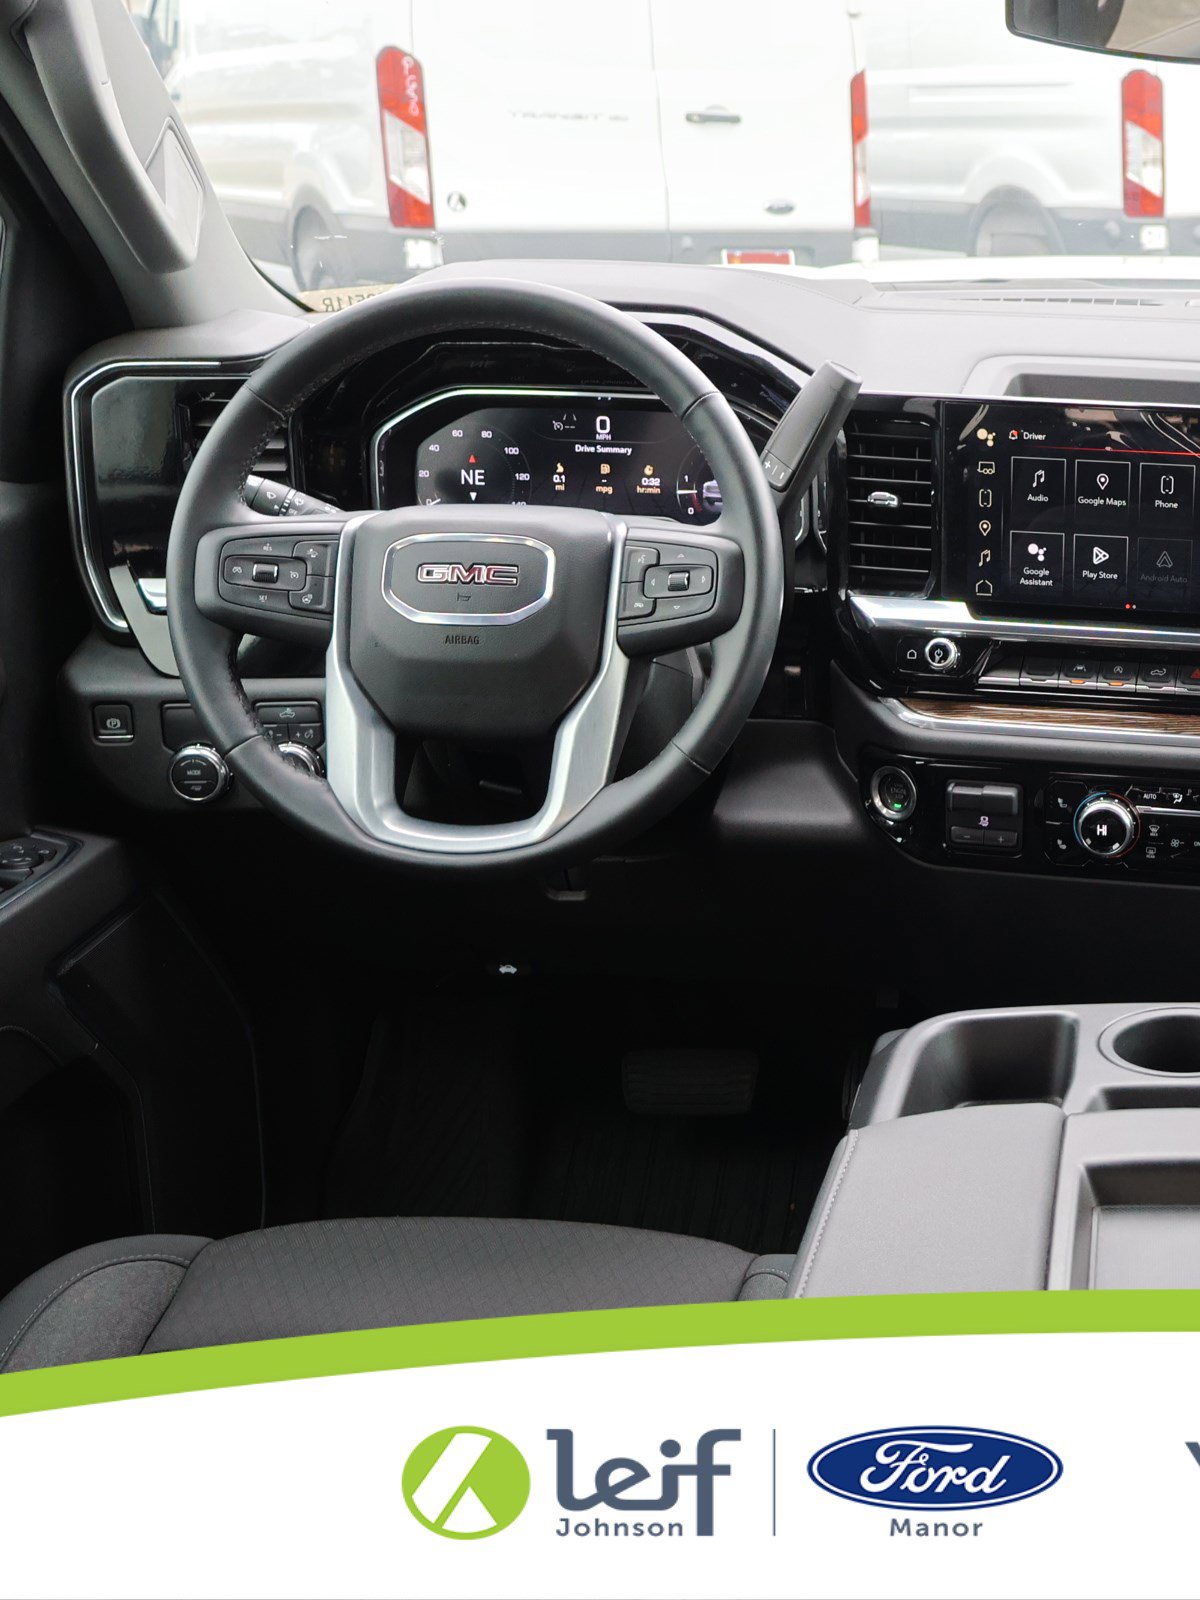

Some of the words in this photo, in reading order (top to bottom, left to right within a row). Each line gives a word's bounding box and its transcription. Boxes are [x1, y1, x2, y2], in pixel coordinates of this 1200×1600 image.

[596, 415, 611, 434] 0
[481, 431, 492, 439] 80
[596, 433, 612, 441] MPH
[1023, 432, 1046, 440] Driver
[429, 444, 440, 452] 40
[504, 447, 519, 455] 100
[575, 444, 595, 453] Drive
[596, 445, 633, 456] Summary
[418, 470, 430, 478] 20
[460, 469, 486, 485] NE
[515, 473, 530, 481] 120
[552, 474, 566, 483] 0.1
[641, 477, 661, 486] 0:32
[595, 485, 613, 495] mpg
[636, 485, 661, 494] hr:min
[1027, 494, 1049, 502] Audio
[1078, 496, 1105, 507] Google
[1106, 497, 1127, 507] Maps
[1155, 500, 1178, 509] Phone
[417, 562, 519, 586] GMC
[1023, 567, 1050, 577] Google
[1082, 570, 1097, 580] Play
[1099, 571, 1118, 579] Store
[1020, 577, 1053, 587] Assistant
[1141, 574, 1169, 582] Android
[1170, 575, 1188, 583] Auto
[445, 635, 480, 645] AIRBAG
[1096, 824, 1108, 836] HI
